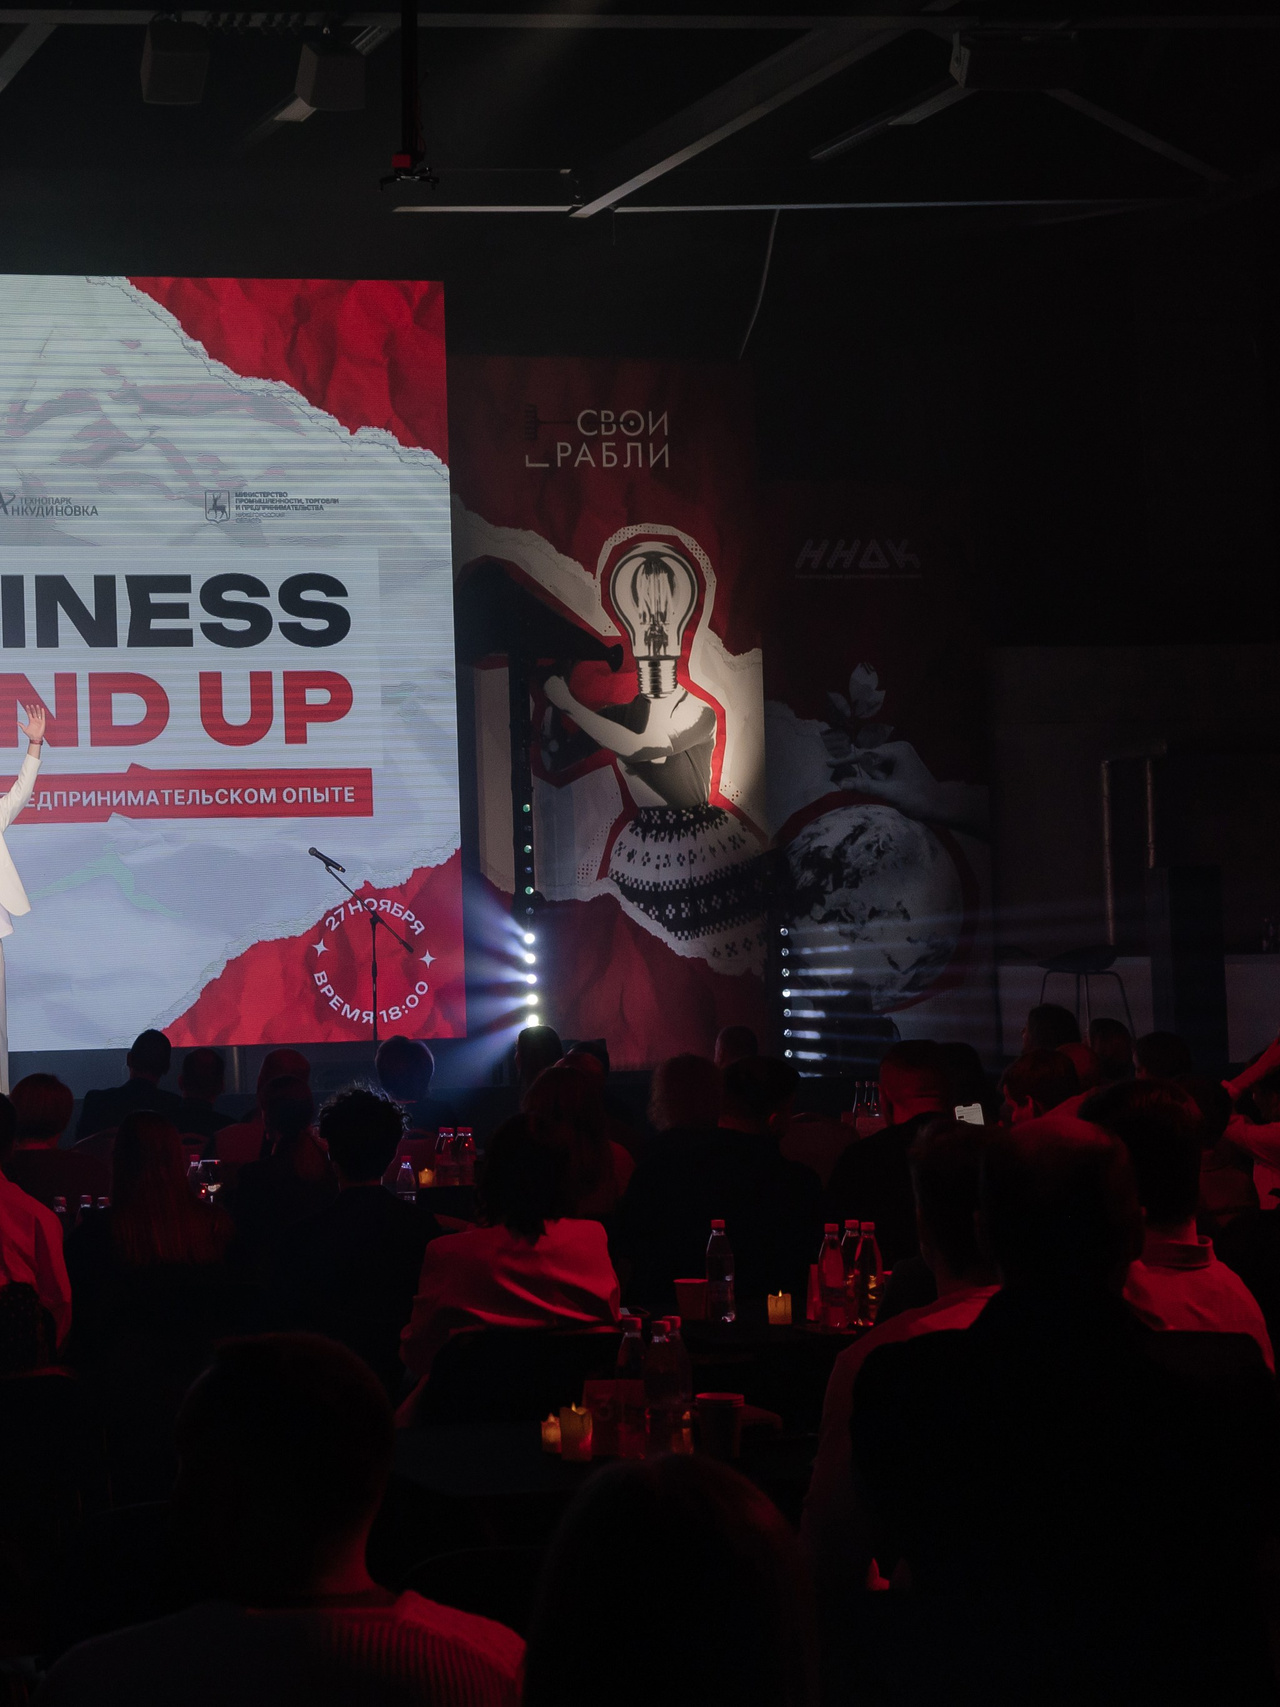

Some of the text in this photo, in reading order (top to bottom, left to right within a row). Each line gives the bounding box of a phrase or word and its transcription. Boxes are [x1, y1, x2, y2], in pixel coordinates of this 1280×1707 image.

[576, 409, 669, 437] СВОИ
[20, 496, 73, 506] ТЕХНОПАРК
[199, 670, 354, 747] UP
[282, 786, 355, 804] ОПЫТЕ
[325, 898, 425, 936] 27 НОЯБРЯ
[313, 970, 429, 1025] ВРЕМЯ 18:00
